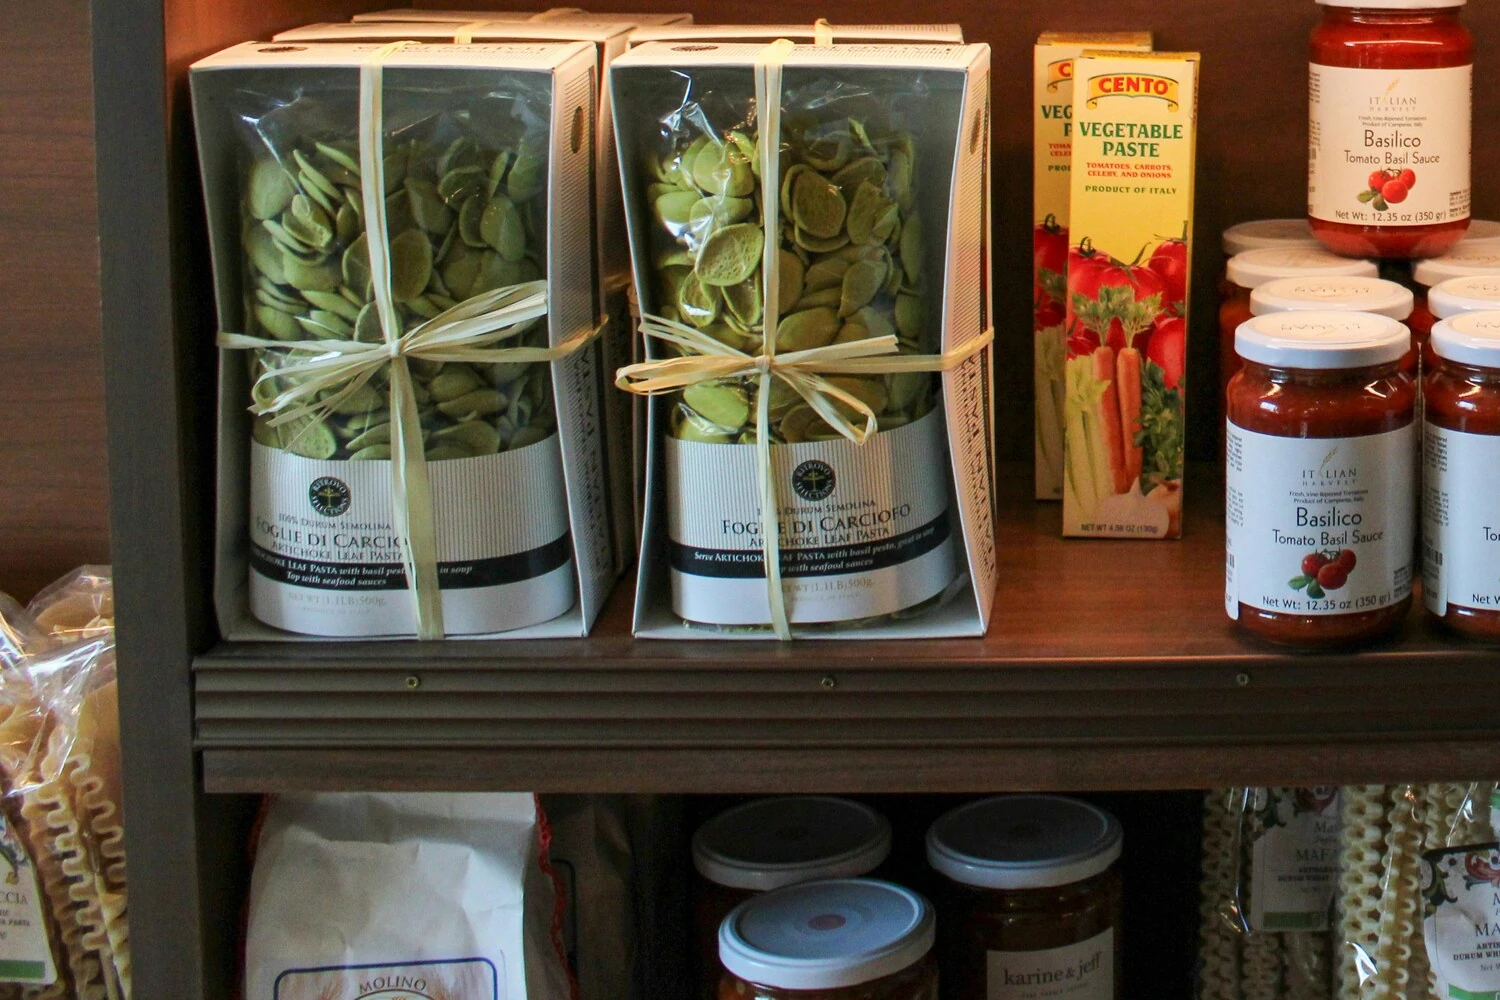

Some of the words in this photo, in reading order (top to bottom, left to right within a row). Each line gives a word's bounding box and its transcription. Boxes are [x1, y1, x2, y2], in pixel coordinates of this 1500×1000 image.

[1098, 77, 1168, 95] CENTO
[1080, 122, 1183, 139] VEGETABLE
[1364, 129, 1421, 147] Basilico
[1102, 142, 1159, 157] PASTE
[1344, 150, 1380, 164] Tomato
[1385, 151, 1408, 164] Basil
[1413, 151, 1440, 163] Sauce
[1087, 163, 1131, 171] TOMATOES,
[1336, 210, 1349, 220] Net
[1352, 211, 1367, 221] Wt:
[1372, 212, 1397, 221] 12.35
[1401, 214, 1411, 222] oz
[826, 500, 876, 512] SEMOLINA
[793, 521, 814, 533] DI
[820, 504, 910, 532] CARCIOFO
[1296, 507, 1362, 527] Basilico
[308, 535, 326, 545] DI
[824, 533, 852, 544] LEAF
[857, 528, 889, 540] PASTA
[1272, 528, 1315, 545] Tomato
[1321, 531, 1347, 545] Basil
[1352, 530, 1383, 544] Sauce
[694, 552, 713, 560] Serve
[797, 551, 826, 561] PASTA
[827, 549, 848, 559] with
[849, 546, 870, 556] basil
[311, 564, 337, 574] PASTA
[339, 567, 360, 575] with
[363, 567, 384, 575] basil
[451, 565, 472, 575] soup
[810, 562, 844, 572] seafood
[846, 559, 873, 568] sauces
[287, 572, 301, 582] Top
[302, 574, 320, 584] with
[323, 576, 356, 588] seafood
[1263, 596, 1279, 607] Net
[1283, 598, 1300, 610] Wt:
[1306, 599, 1335, 610] 12.35
[1339, 601, 1351, 610] oz
[1356, 597, 1377, 609] (350
[1472, 594, 1490, 604] Net
[1453, 952, 1483, 960] DURUM
[1003, 966, 1064, 985] karine
[360, 976, 426, 994] MOLINO
